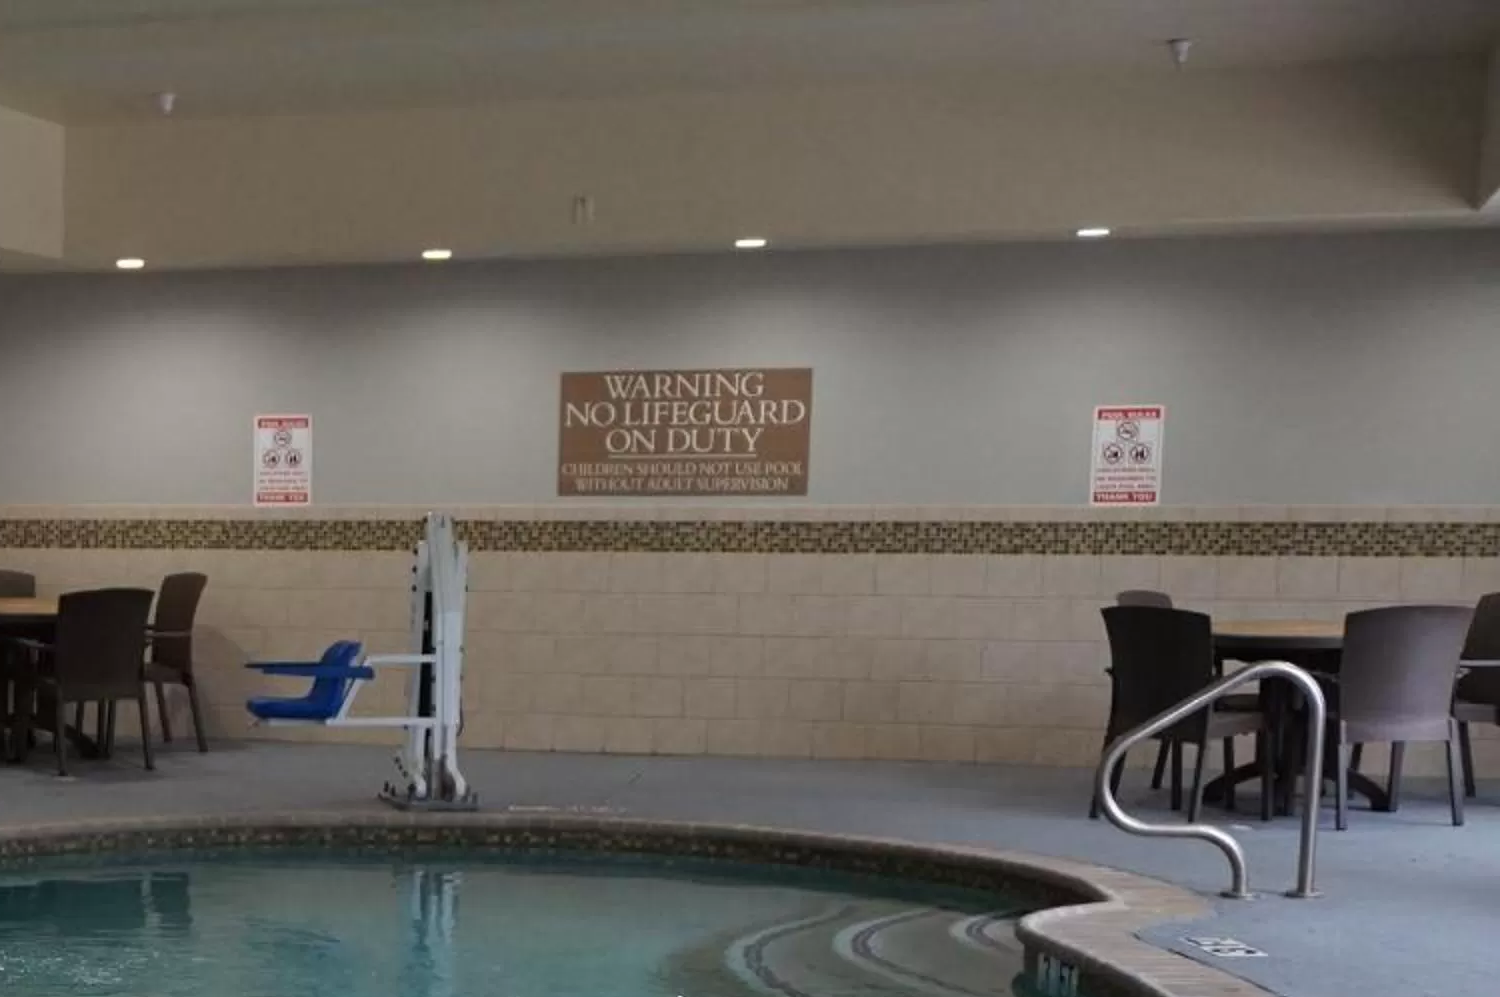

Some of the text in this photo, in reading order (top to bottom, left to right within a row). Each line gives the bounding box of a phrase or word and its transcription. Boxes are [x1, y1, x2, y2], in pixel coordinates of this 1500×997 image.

[604, 371, 764, 399] WARNING
[565, 400, 806, 428] NO LIFEGUARD
[605, 428, 764, 453] ON DUTY
[561, 461, 802, 476] CHILDREN SHOULD NOT USE POOL
[575, 477, 789, 492] WITHOUT ADULT SUPERVISION
